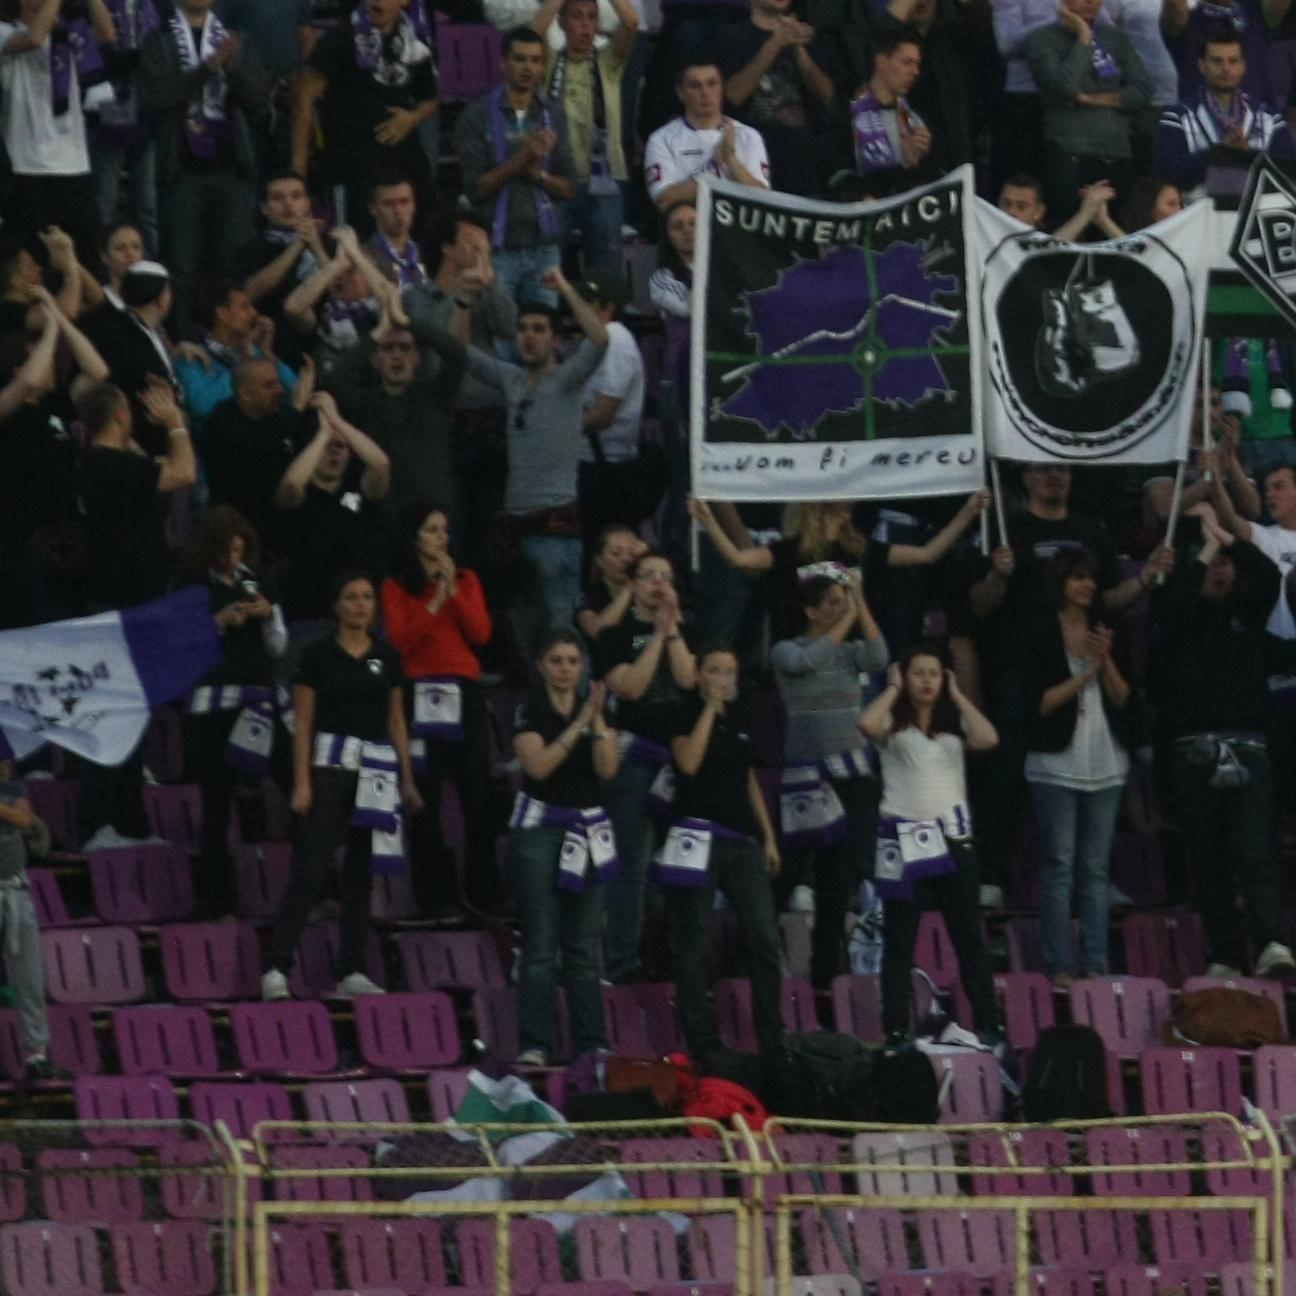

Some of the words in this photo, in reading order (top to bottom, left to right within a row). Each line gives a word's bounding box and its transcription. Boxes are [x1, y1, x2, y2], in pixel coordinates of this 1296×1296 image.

[713, 198, 863, 245] SUNTEM
[873, 189, 958, 234] AICI
[818, 445, 848, 471] fi
